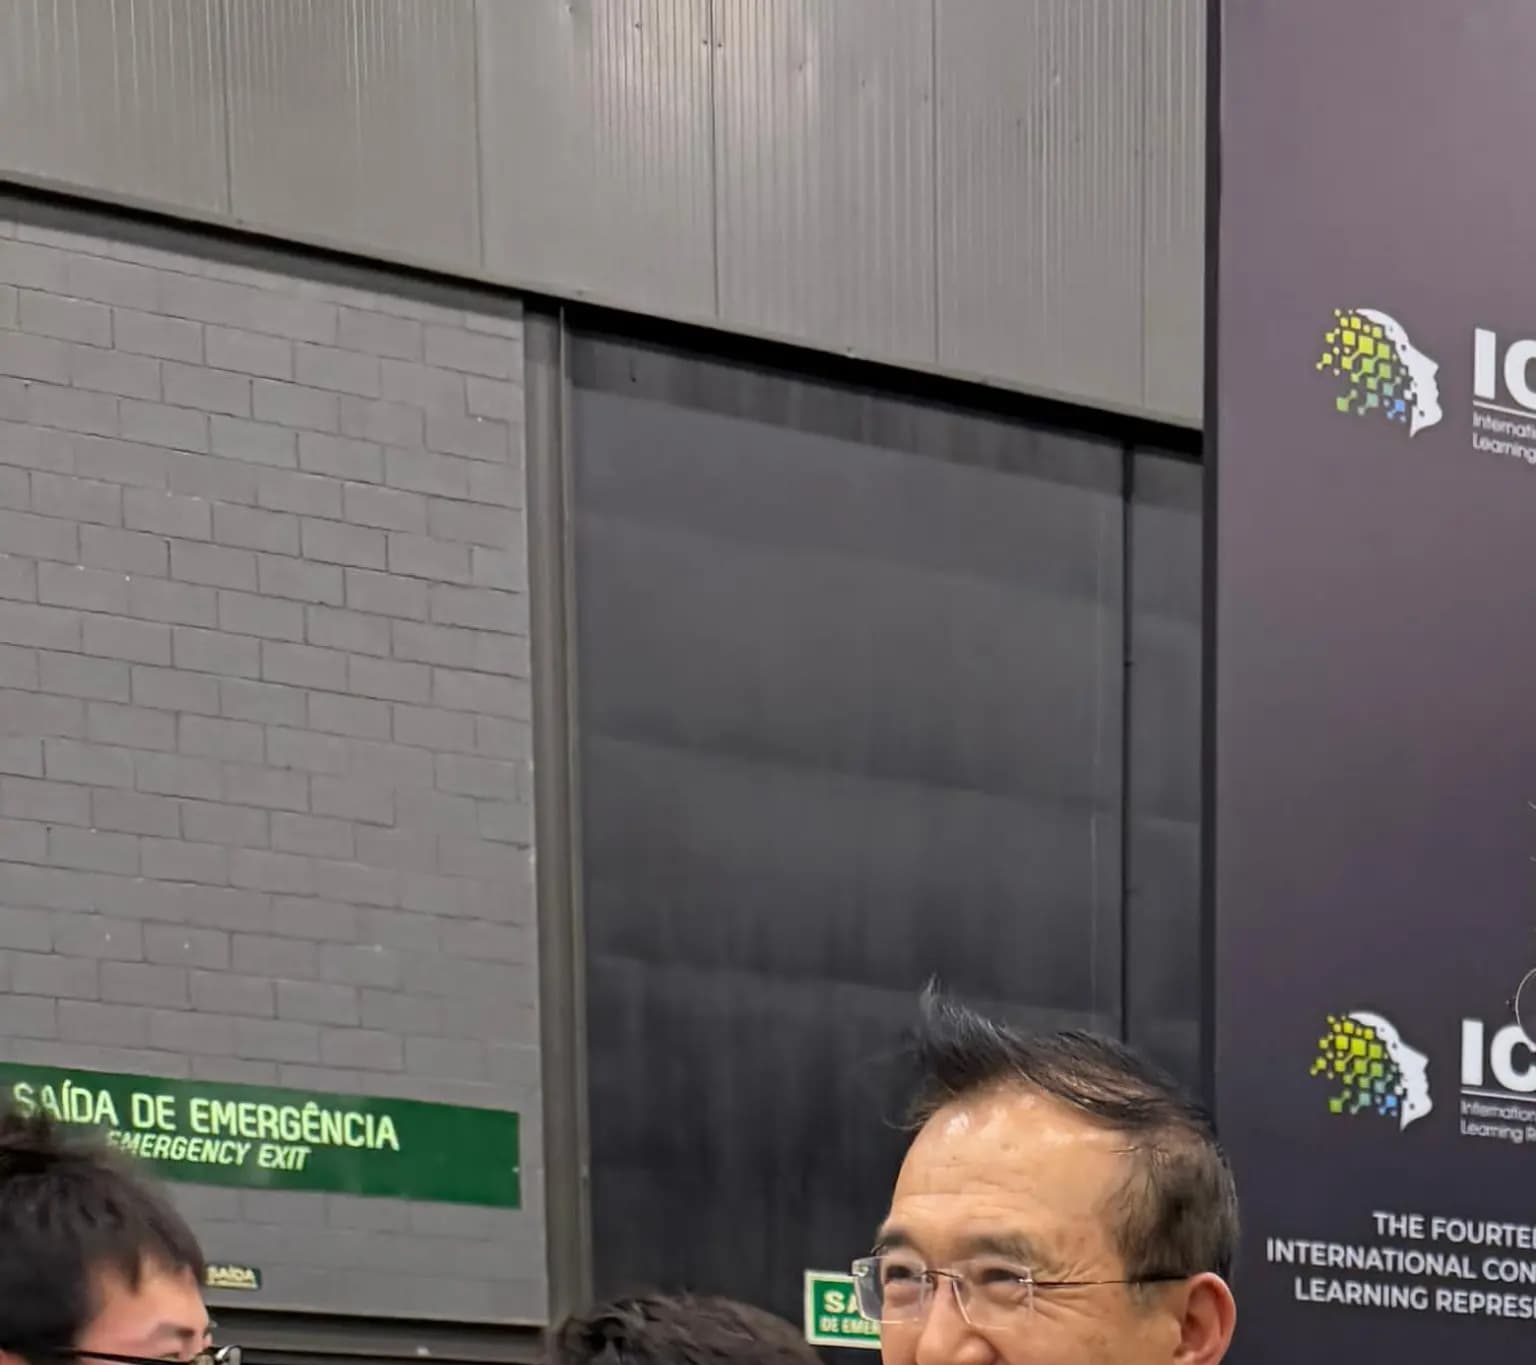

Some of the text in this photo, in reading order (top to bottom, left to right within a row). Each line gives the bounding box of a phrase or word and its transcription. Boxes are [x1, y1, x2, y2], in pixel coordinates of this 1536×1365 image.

[13, 1079, 400, 1150] SAÍDA DE EMERGÊNCIA
[1460, 1119, 1523, 1143] Learning
[107, 1130, 312, 1171] EMERGENCY EXIT
[1373, 1211, 1424, 1240] THE
[1266, 1239, 1477, 1281] INTERNATIONAL
[1295, 1277, 1429, 1312] LEARNING
